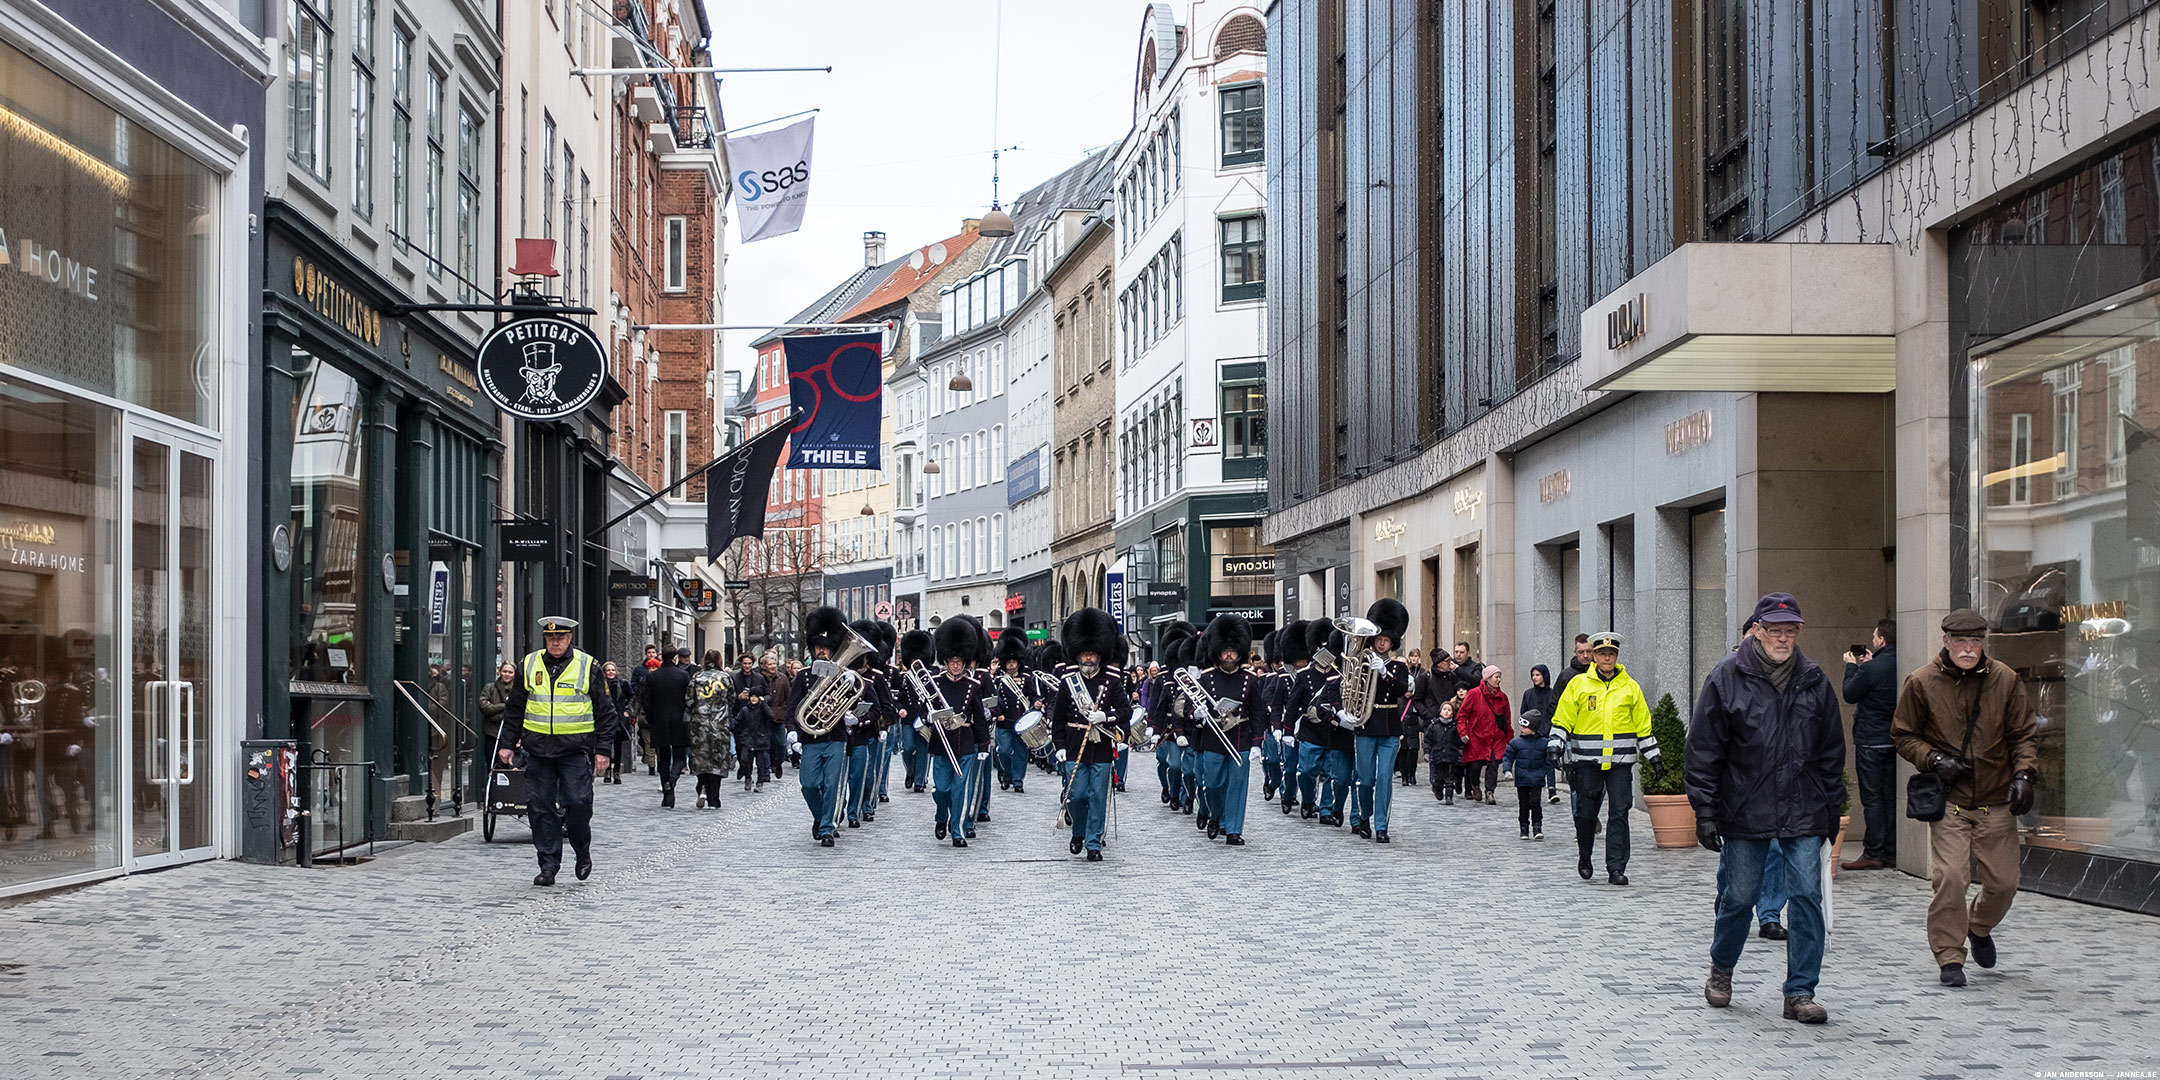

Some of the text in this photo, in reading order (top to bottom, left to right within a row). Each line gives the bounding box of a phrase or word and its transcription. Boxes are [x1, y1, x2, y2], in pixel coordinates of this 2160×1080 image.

[761, 160, 809, 193] sas
[29, 239, 98, 301] HOME
[316, 270, 363, 338] PETITGAS
[505, 323, 580, 346] PETITGAS
[729, 446, 754, 494] CHOO
[801, 449, 867, 465] THIELE
[11, 548, 85, 573] ZARA HOME
